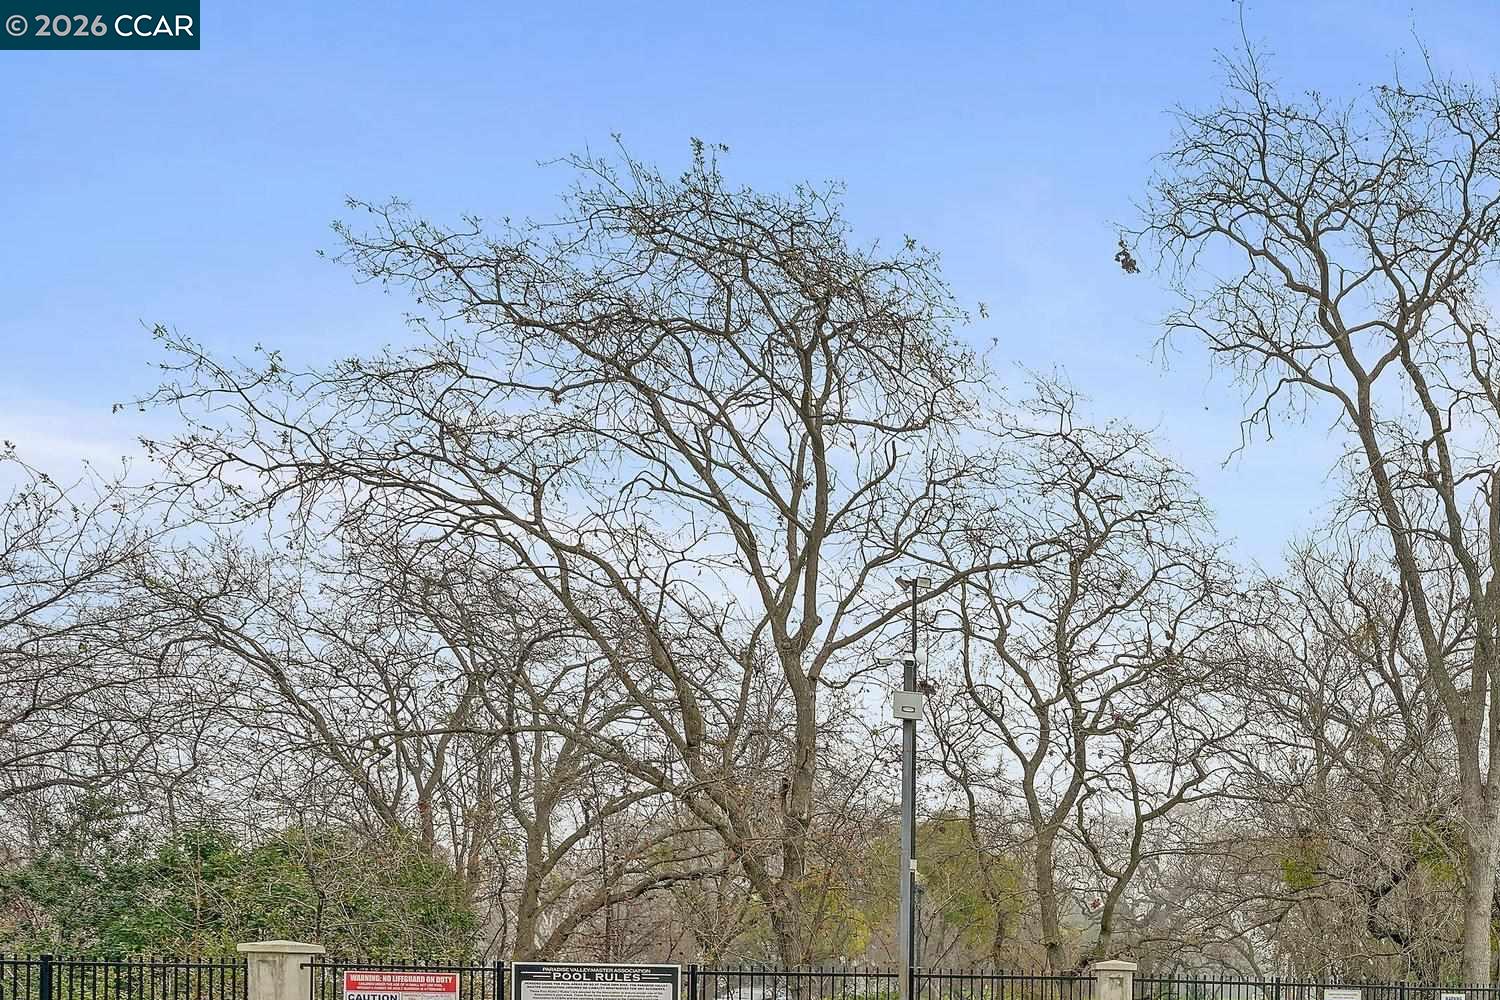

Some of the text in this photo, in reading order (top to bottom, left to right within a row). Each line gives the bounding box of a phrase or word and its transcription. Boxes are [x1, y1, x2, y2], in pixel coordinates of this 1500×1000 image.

[392, 975, 425, 983] LIFEGUARD
[426, 975, 435, 983] ON
[552, 972, 641, 982] POOL RULES
